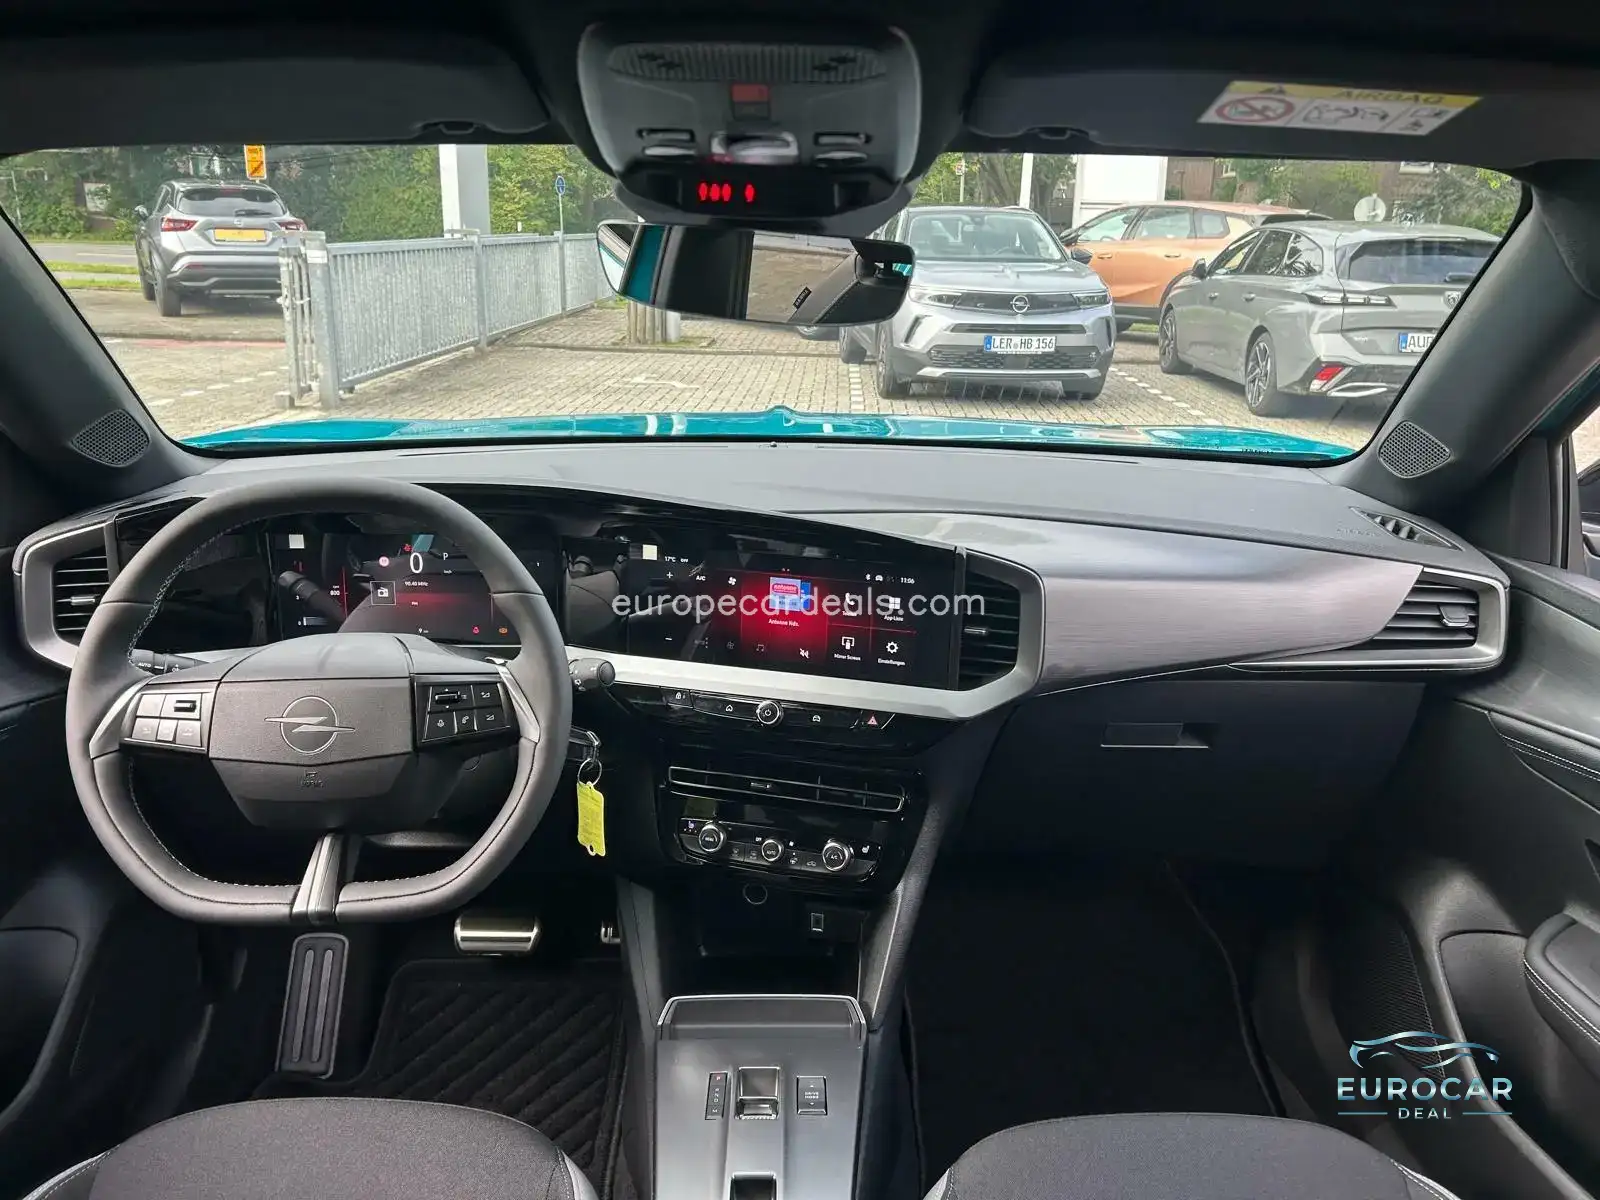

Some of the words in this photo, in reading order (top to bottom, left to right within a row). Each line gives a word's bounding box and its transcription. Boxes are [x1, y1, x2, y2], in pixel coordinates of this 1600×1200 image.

[1333, 88, 1444, 105] AIRBAG
[992, 337, 1012, 350] LER
[1020, 337, 1033, 350] HB
[1035, 337, 1054, 350] 156
[410, 552, 424, 574] 0
